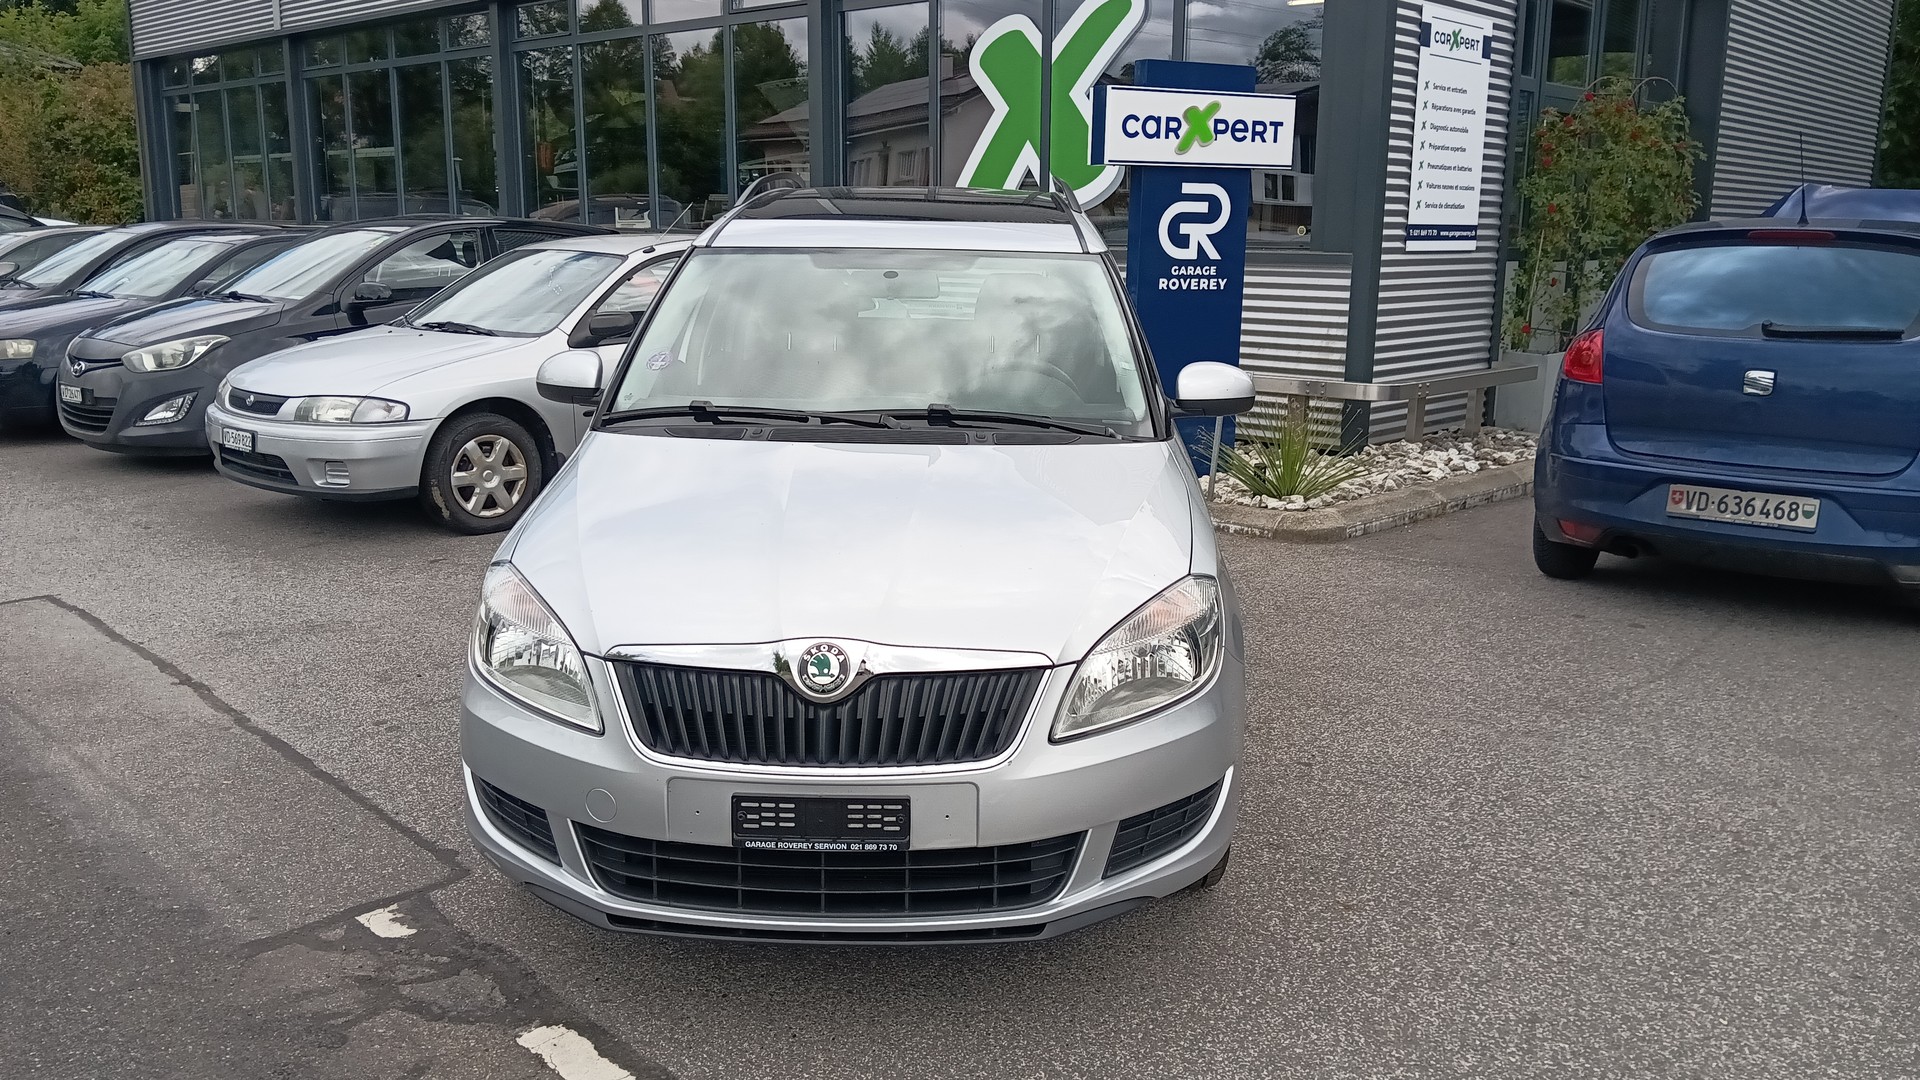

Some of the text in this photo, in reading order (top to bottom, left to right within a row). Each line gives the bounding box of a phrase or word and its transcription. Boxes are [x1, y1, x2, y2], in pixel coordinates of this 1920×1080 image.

[1433, 83, 1446, 92] Service
[1430, 122, 1449, 132] Diagnostic
[1426, 182, 1441, 190] Voitures
[1171, 265, 1217, 276] GARAGE
[1158, 277, 1228, 290] ROVEREY
[745, 841, 776, 849] GARAGE
[777, 842, 813, 850] ROVEREY
[864, 843, 878, 851] 869
[879, 843, 888, 851] 73
